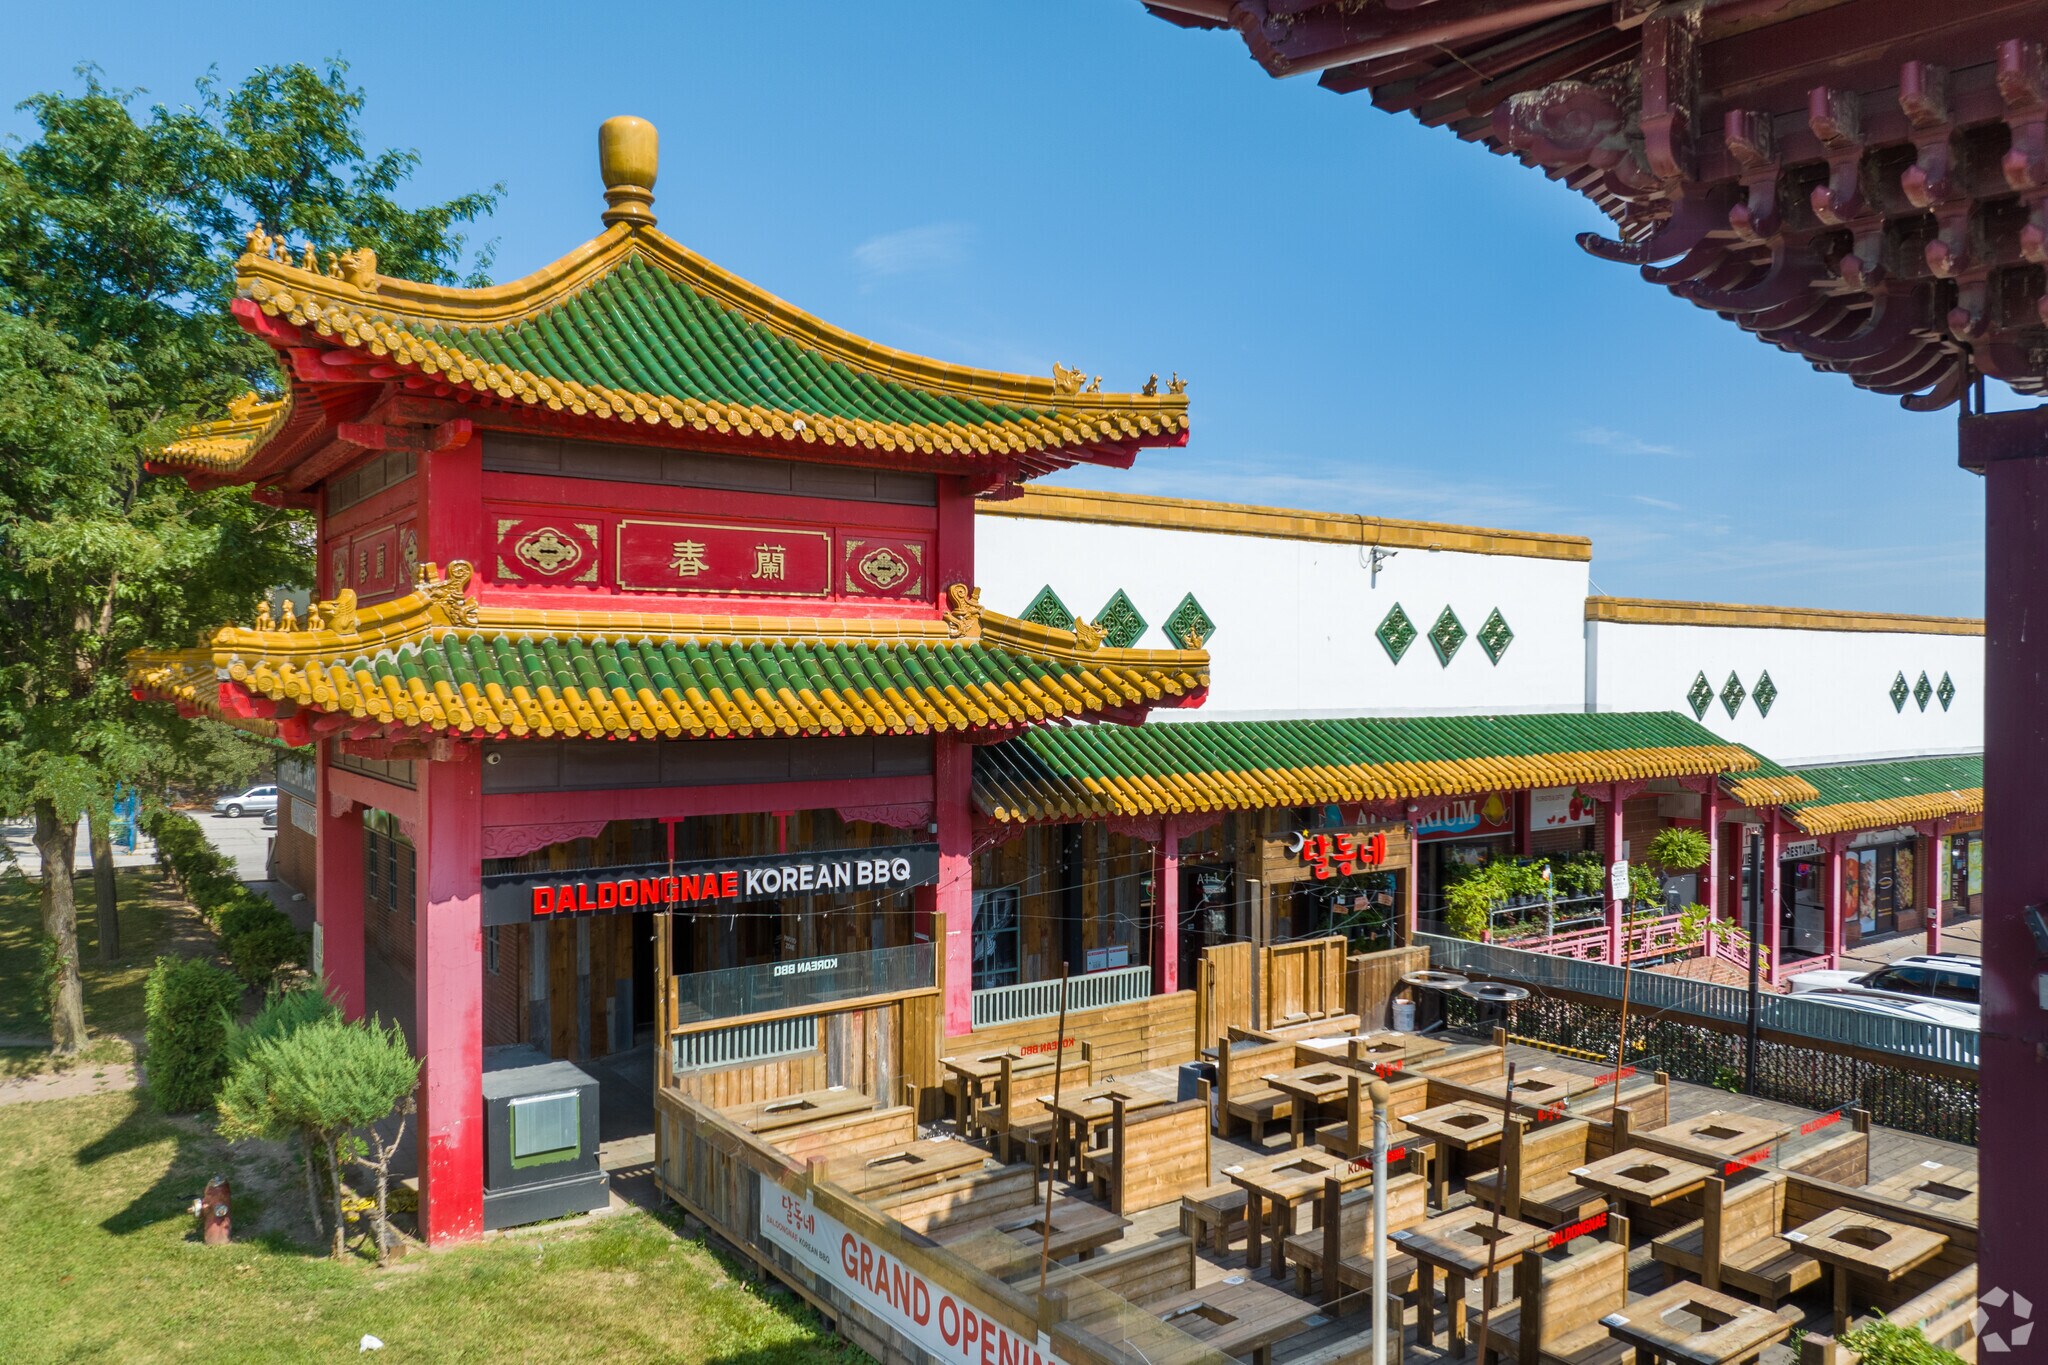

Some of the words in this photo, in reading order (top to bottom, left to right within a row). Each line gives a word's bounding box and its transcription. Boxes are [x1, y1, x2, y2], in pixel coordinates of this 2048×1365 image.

[1303, 832, 1386, 880] 달동네
[532, 870, 738, 915] DALDONGNAE
[744, 861, 850, 896] KOREAN
[854, 857, 911, 886] BBQ
[781, 1195, 815, 1236] 달동네
[1547, 1212, 1608, 1249] DALDONGNAE
[798, 1237, 819, 1257] KOREAN
[818, 1250, 831, 1265] BBQ
[841, 1232, 931, 1327] GRAND
[938, 1295, 1055, 1365] OPEN
